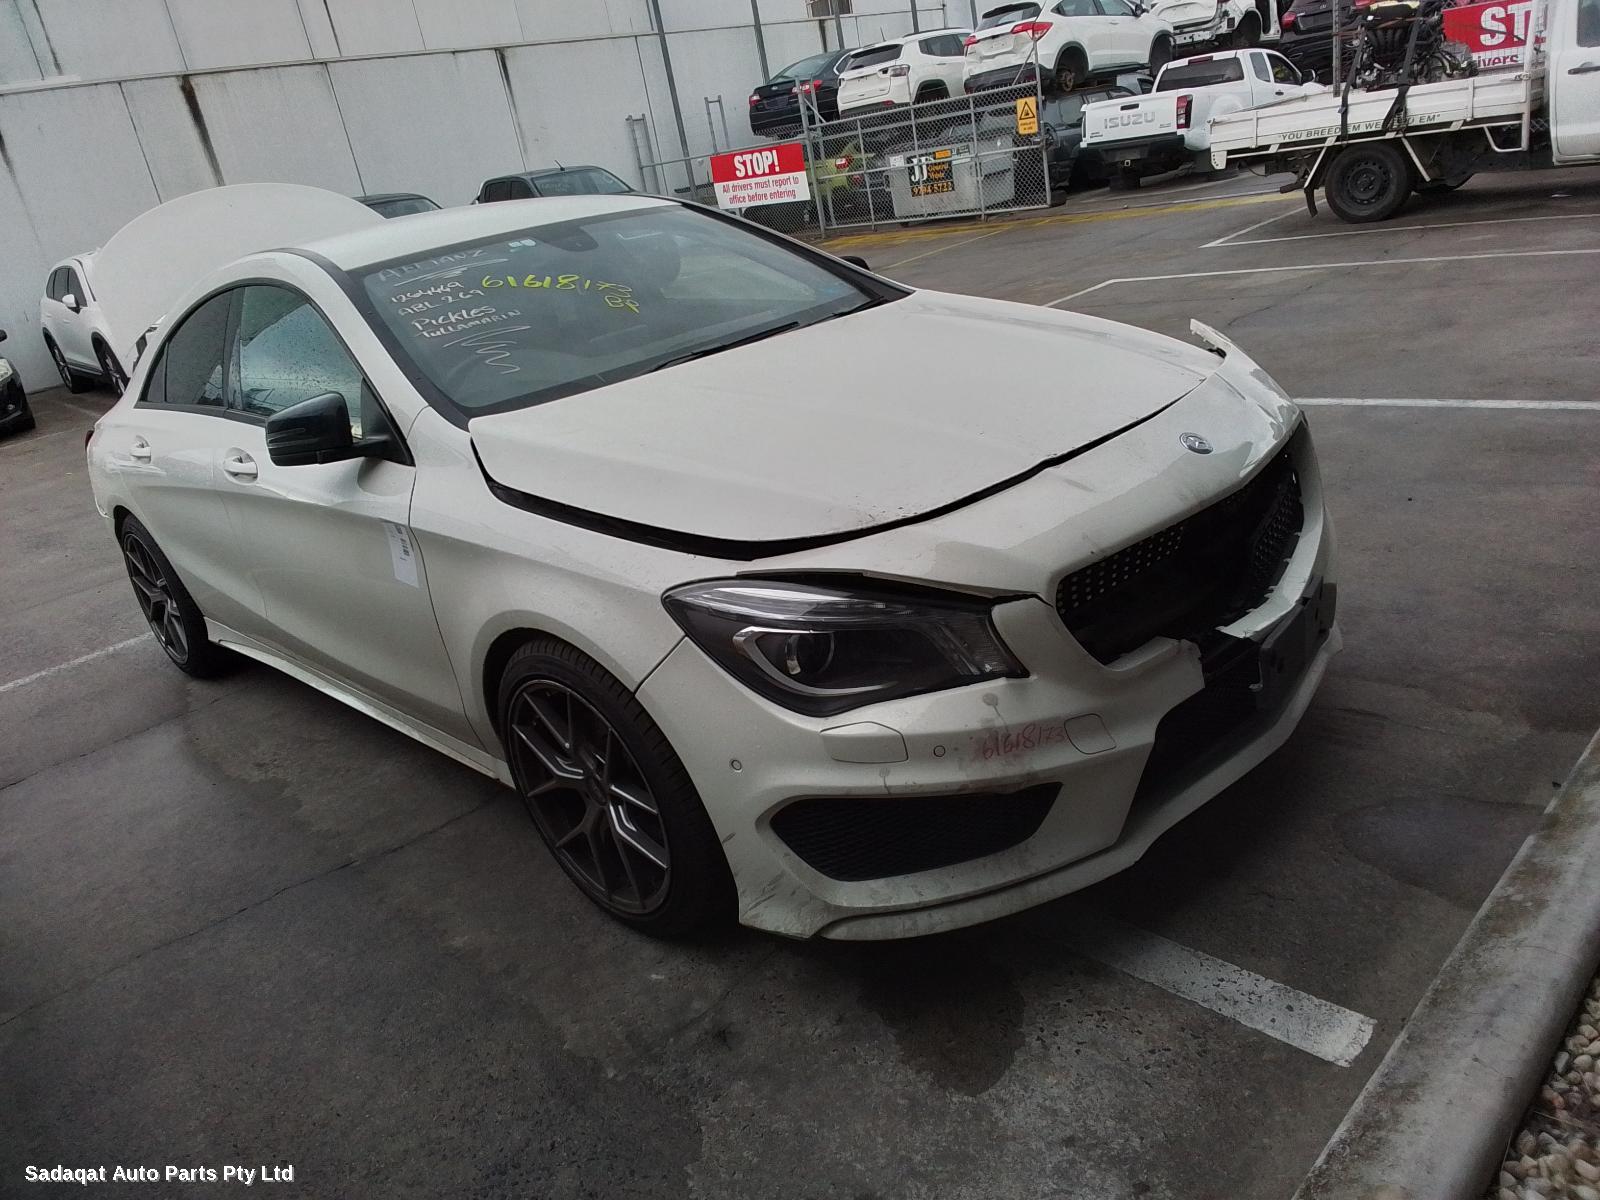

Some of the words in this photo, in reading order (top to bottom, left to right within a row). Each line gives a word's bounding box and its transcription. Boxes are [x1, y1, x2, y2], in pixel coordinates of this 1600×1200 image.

[1480, 2, 1533, 46] ST
[1477, 54, 1519, 67] ivers
[1104, 112, 1155, 129] ISUZU
[1306, 126, 1342, 136] BREED
[733, 149, 780, 178] STOP!
[722, 183, 731, 194] All
[731, 182, 753, 193] drivers
[754, 178, 771, 190] must
[772, 176, 792, 189] report
[792, 175, 799, 185] to
[729, 193, 747, 205] office
[747, 190, 768, 202] before
[769, 188, 797, 200] entering
